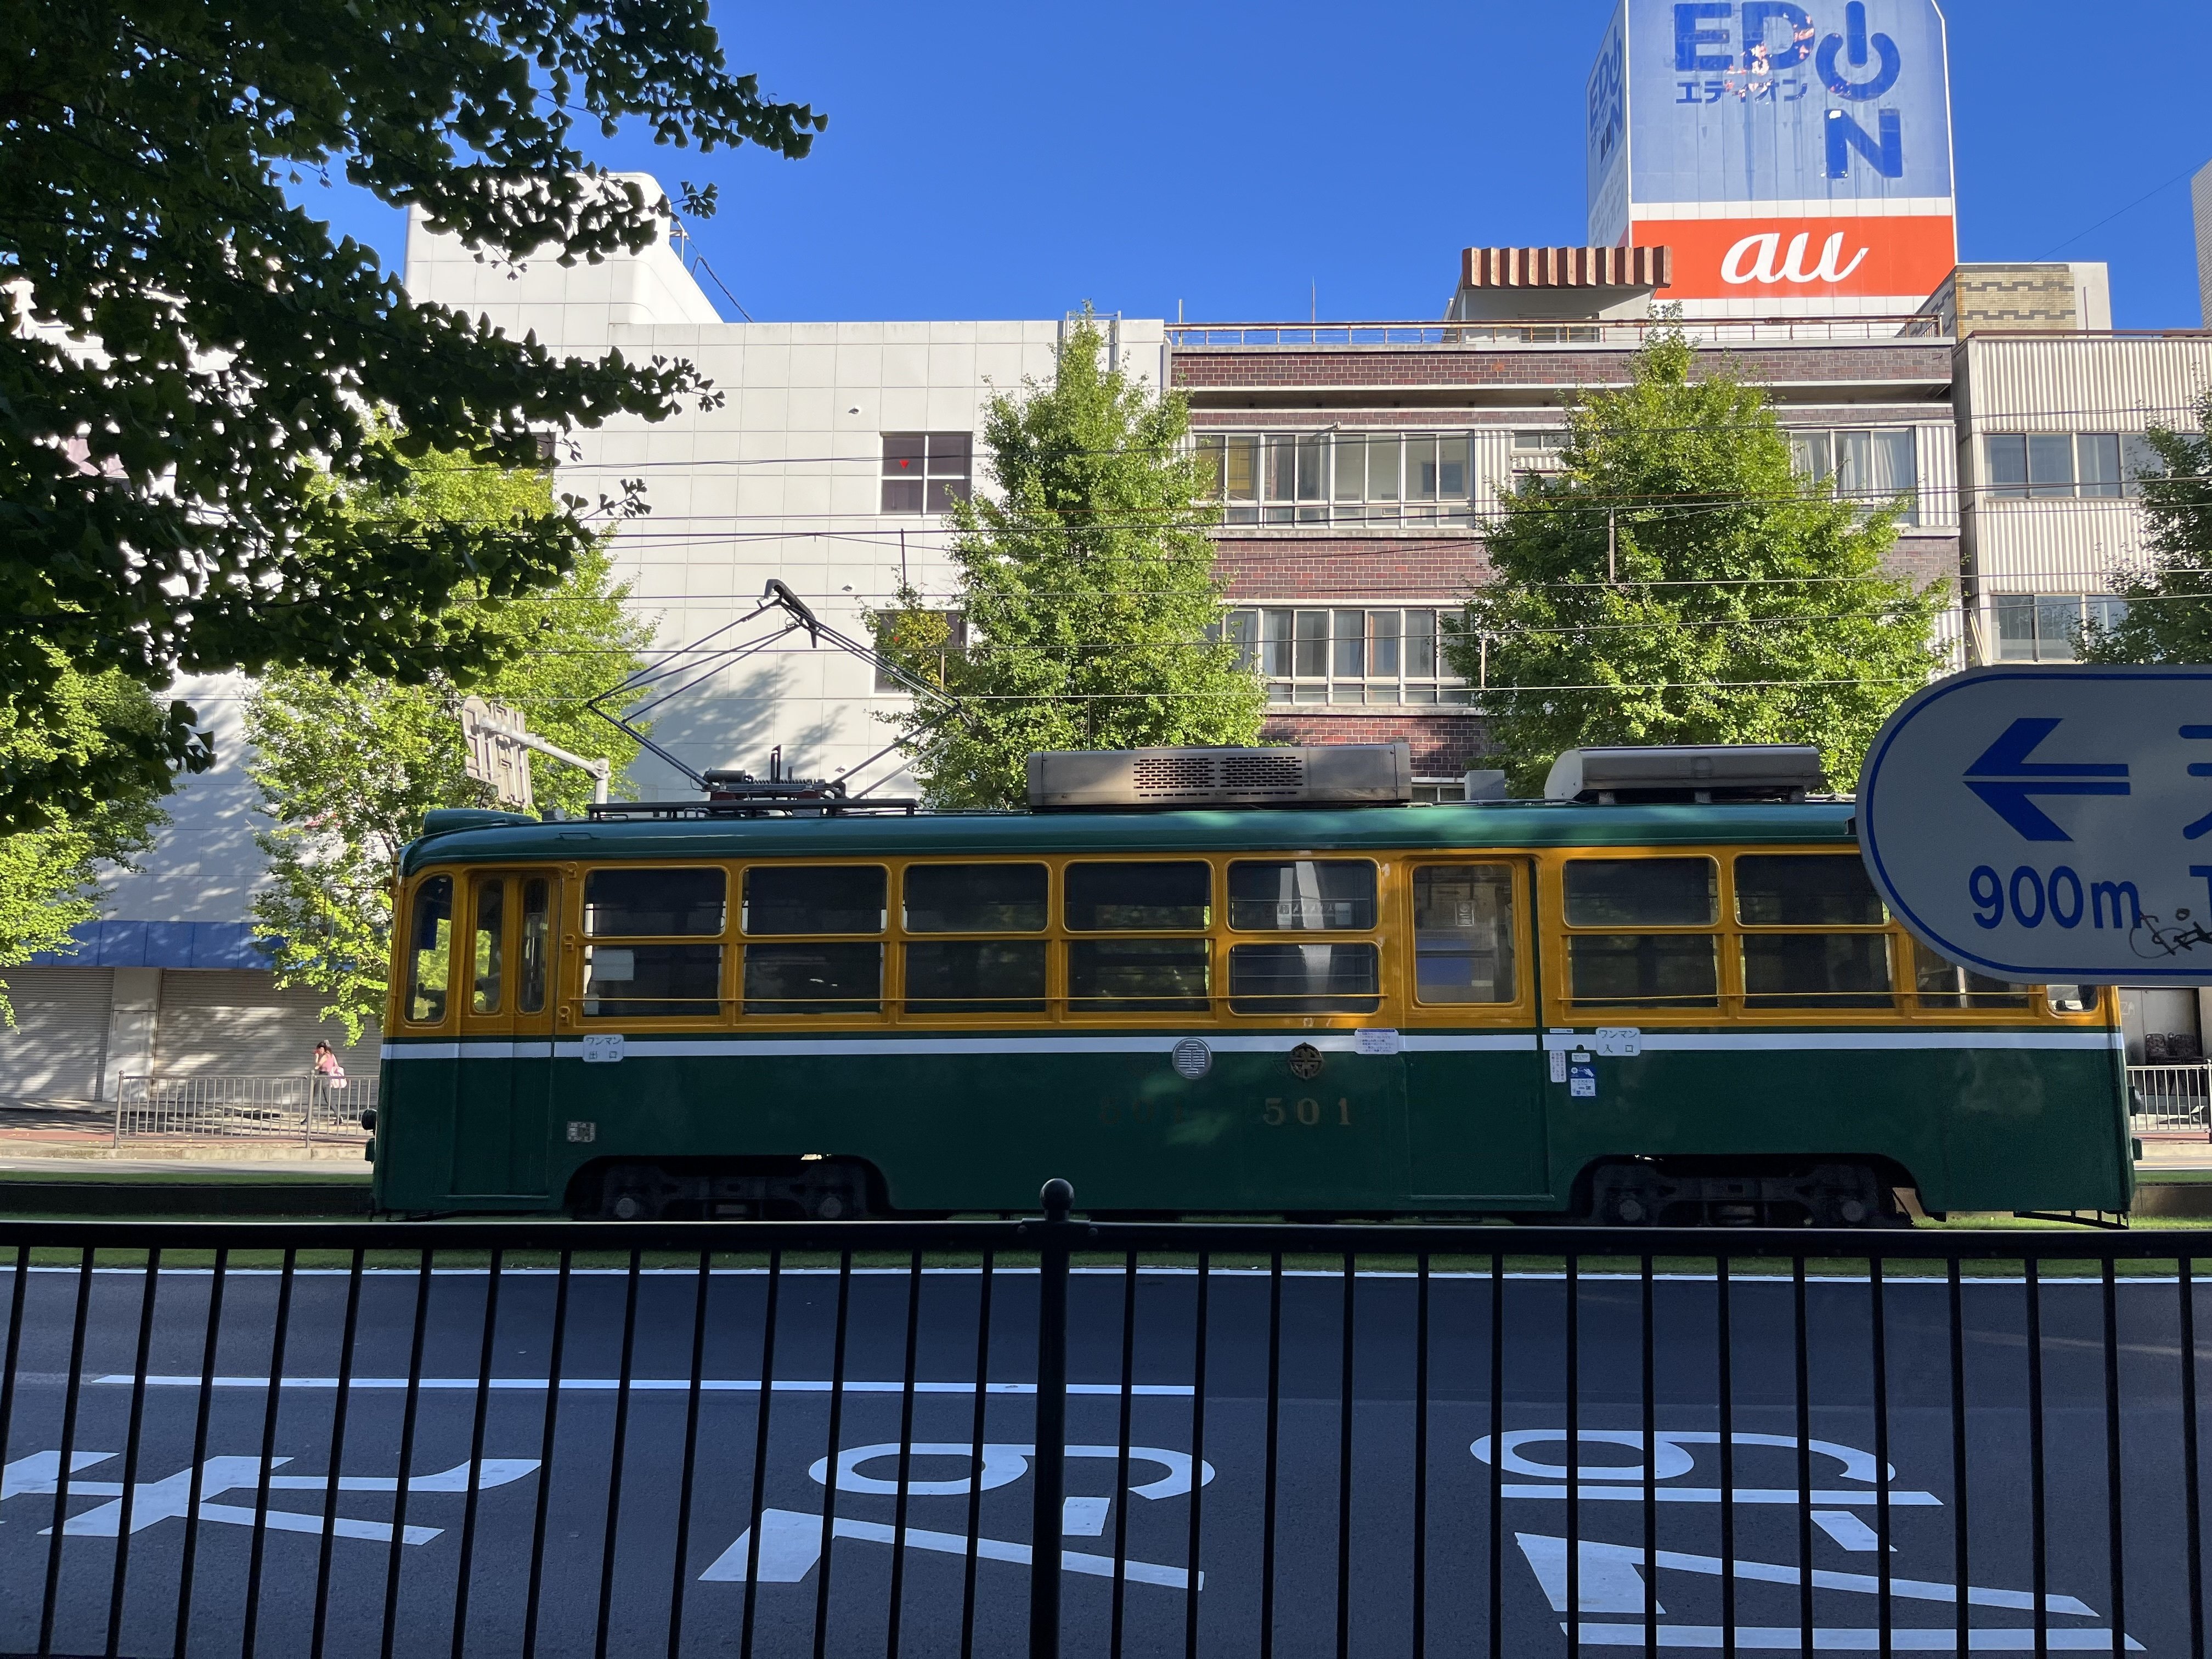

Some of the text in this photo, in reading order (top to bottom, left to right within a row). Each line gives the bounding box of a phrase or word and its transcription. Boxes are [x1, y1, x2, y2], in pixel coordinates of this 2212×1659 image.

[1720, 232, 1869, 284] au
[1968, 865, 2141, 929] 900m
[1599, 1030, 1638, 1039] ワンマン
[586, 1037, 622, 1045] ワンマン
[1603, 1044, 1634, 1053] 入口
[589, 1051, 618, 1059] 出口
[1262, 1097, 1352, 1126] 501
